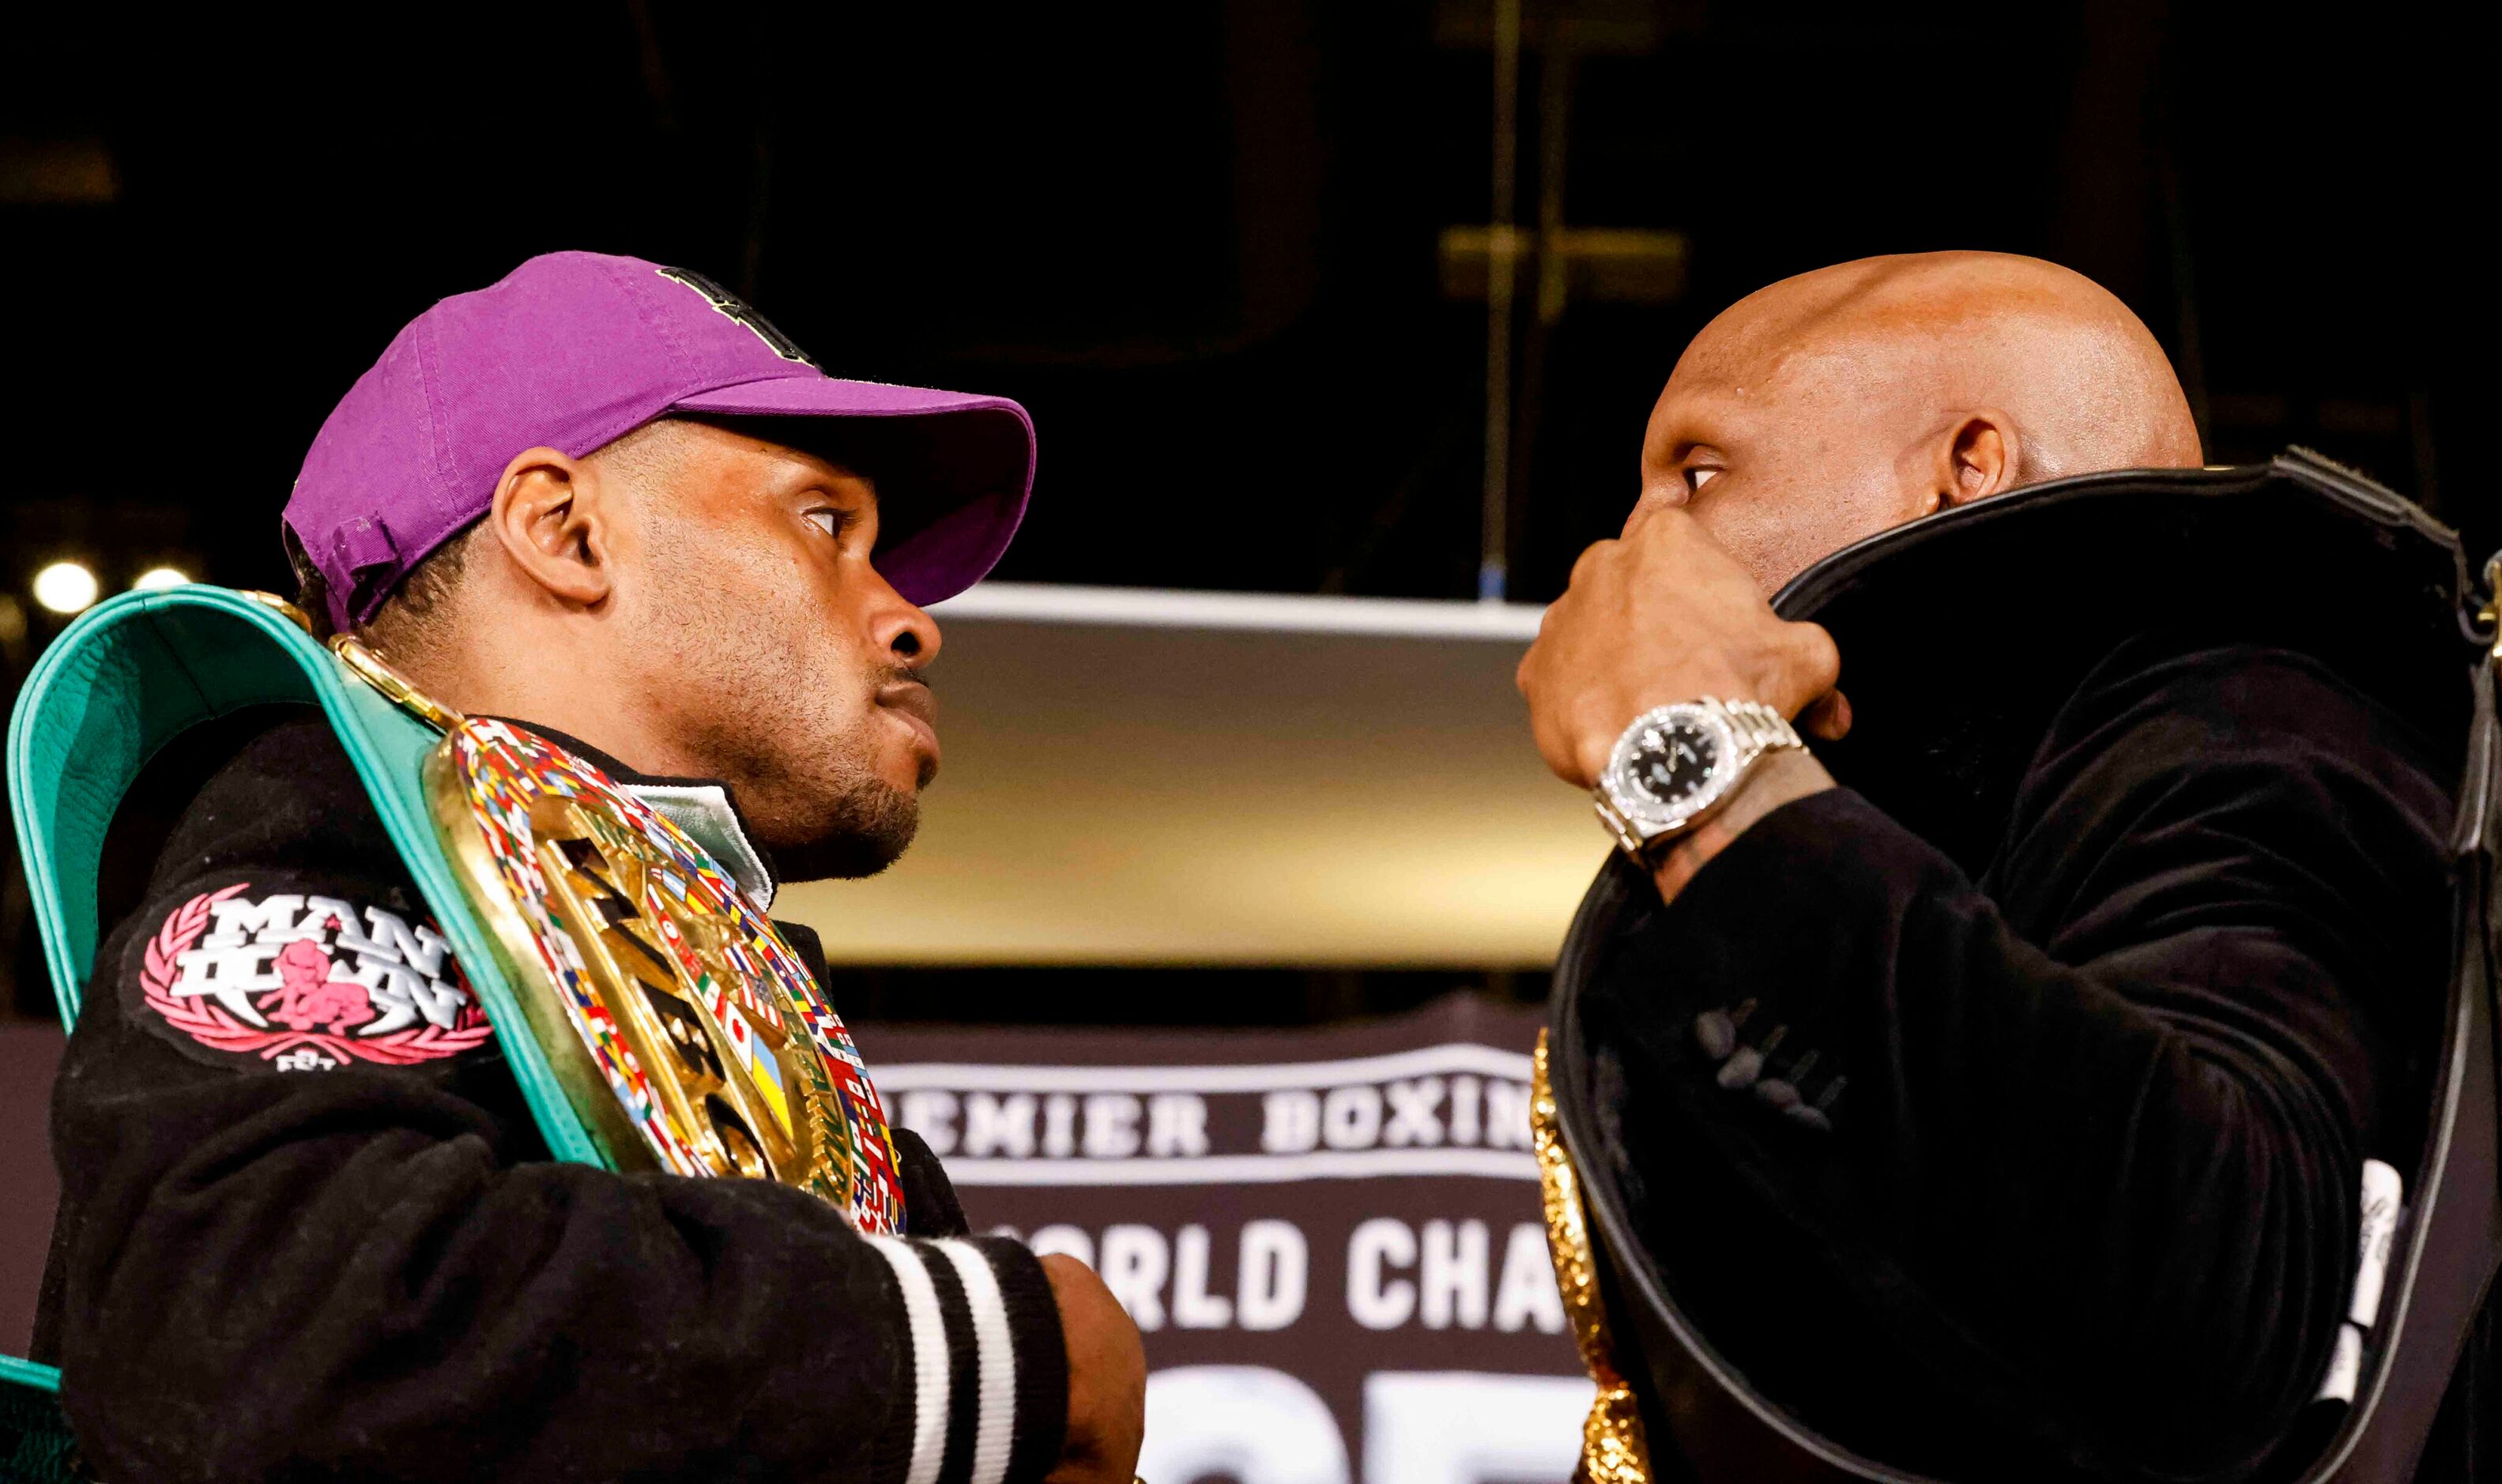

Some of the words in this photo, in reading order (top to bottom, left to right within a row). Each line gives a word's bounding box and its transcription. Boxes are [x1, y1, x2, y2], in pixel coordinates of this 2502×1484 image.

[203, 895, 450, 978] MAN
[550, 836, 778, 1181] WBC
[874, 1090, 1208, 1157] EMIER
[991, 1219, 1309, 1331] RLD
[1345, 1217, 1565, 1333] CHA
